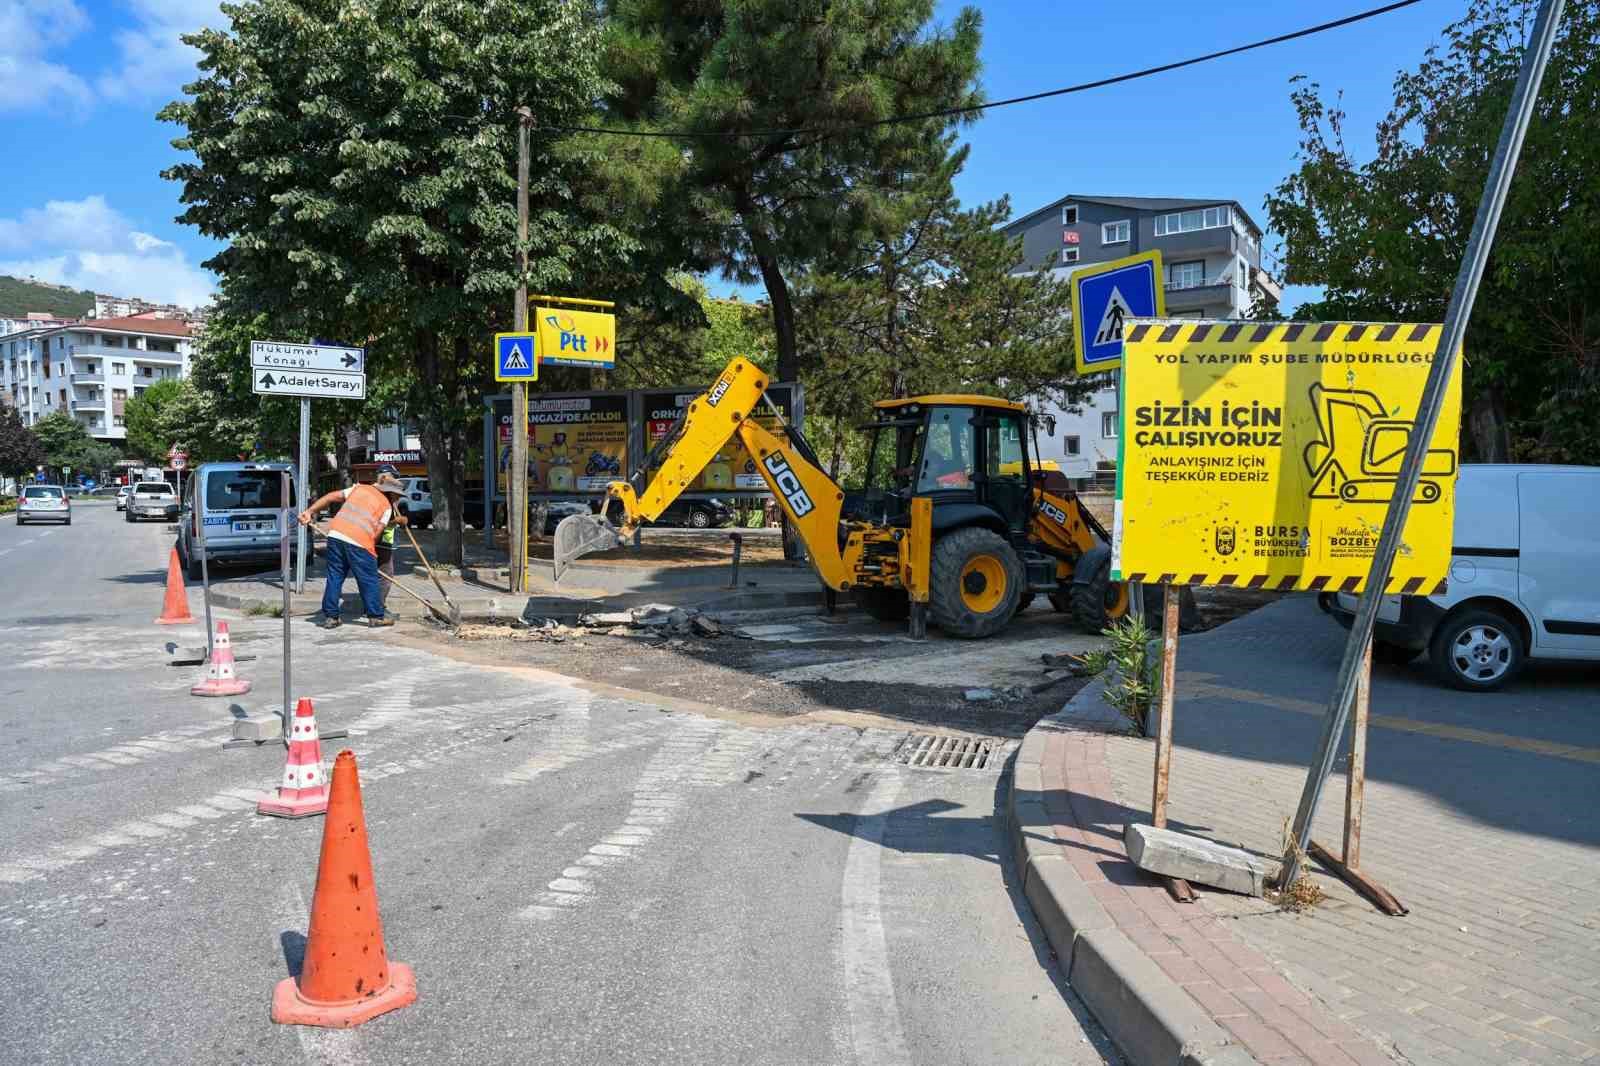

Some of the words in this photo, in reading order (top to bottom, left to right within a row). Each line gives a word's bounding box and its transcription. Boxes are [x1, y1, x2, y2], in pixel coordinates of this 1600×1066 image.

[560, 332, 587, 352] Ptt
[1154, 354, 1189, 364] YOL
[1196, 354, 1253, 364] YAPIM
[1259, 353, 1309, 365] ŞUBE
[1315, 351, 1435, 364] MÜDÜRLÜĞÜ
[1135, 400, 1211, 427] SİZİN
[1222, 400, 1281, 430] İÇİN
[1135, 431, 1282, 448] ÇALIŞIYORUZ
[1150, 457, 1234, 470] ANLAYIŞINIZ
[1238, 455, 1265, 470] İÇİN
[1146, 470, 1216, 483] TEŞEKKÜR
[1220, 470, 1270, 482] EDERİZ
[765, 457, 814, 517] JCB
[1040, 501, 1066, 524] JCB
[1254, 537, 1303, 548] BÜYÜKŞE
[1330, 537, 1377, 546] BOZBEY
